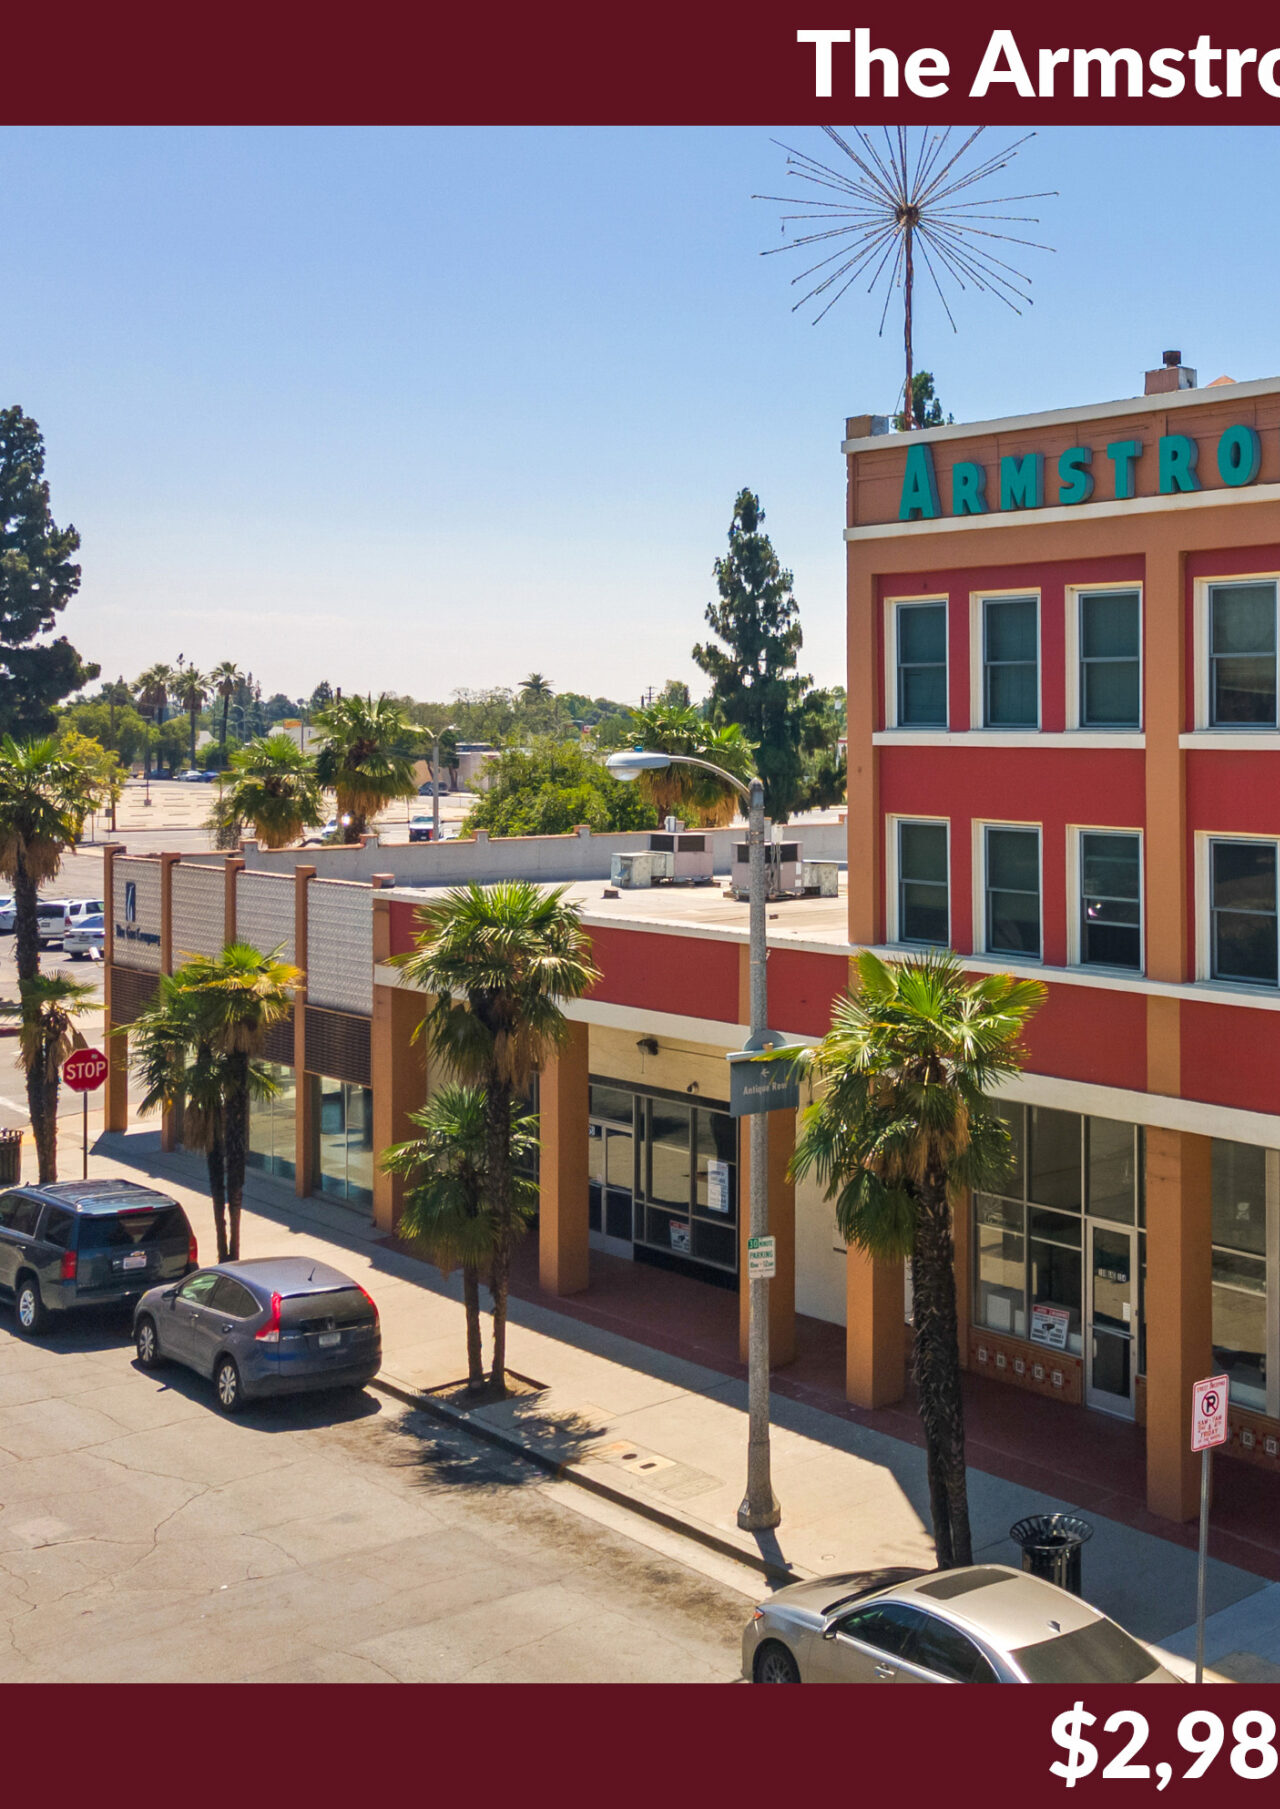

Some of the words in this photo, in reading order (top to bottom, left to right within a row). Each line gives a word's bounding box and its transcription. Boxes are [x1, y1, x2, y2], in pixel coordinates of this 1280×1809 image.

[66, 1061, 106, 1081] STOP
[743, 1083, 770, 1096] Antique
[749, 1239, 759, 1249] 30
[750, 1250, 773, 1259] PARKING
